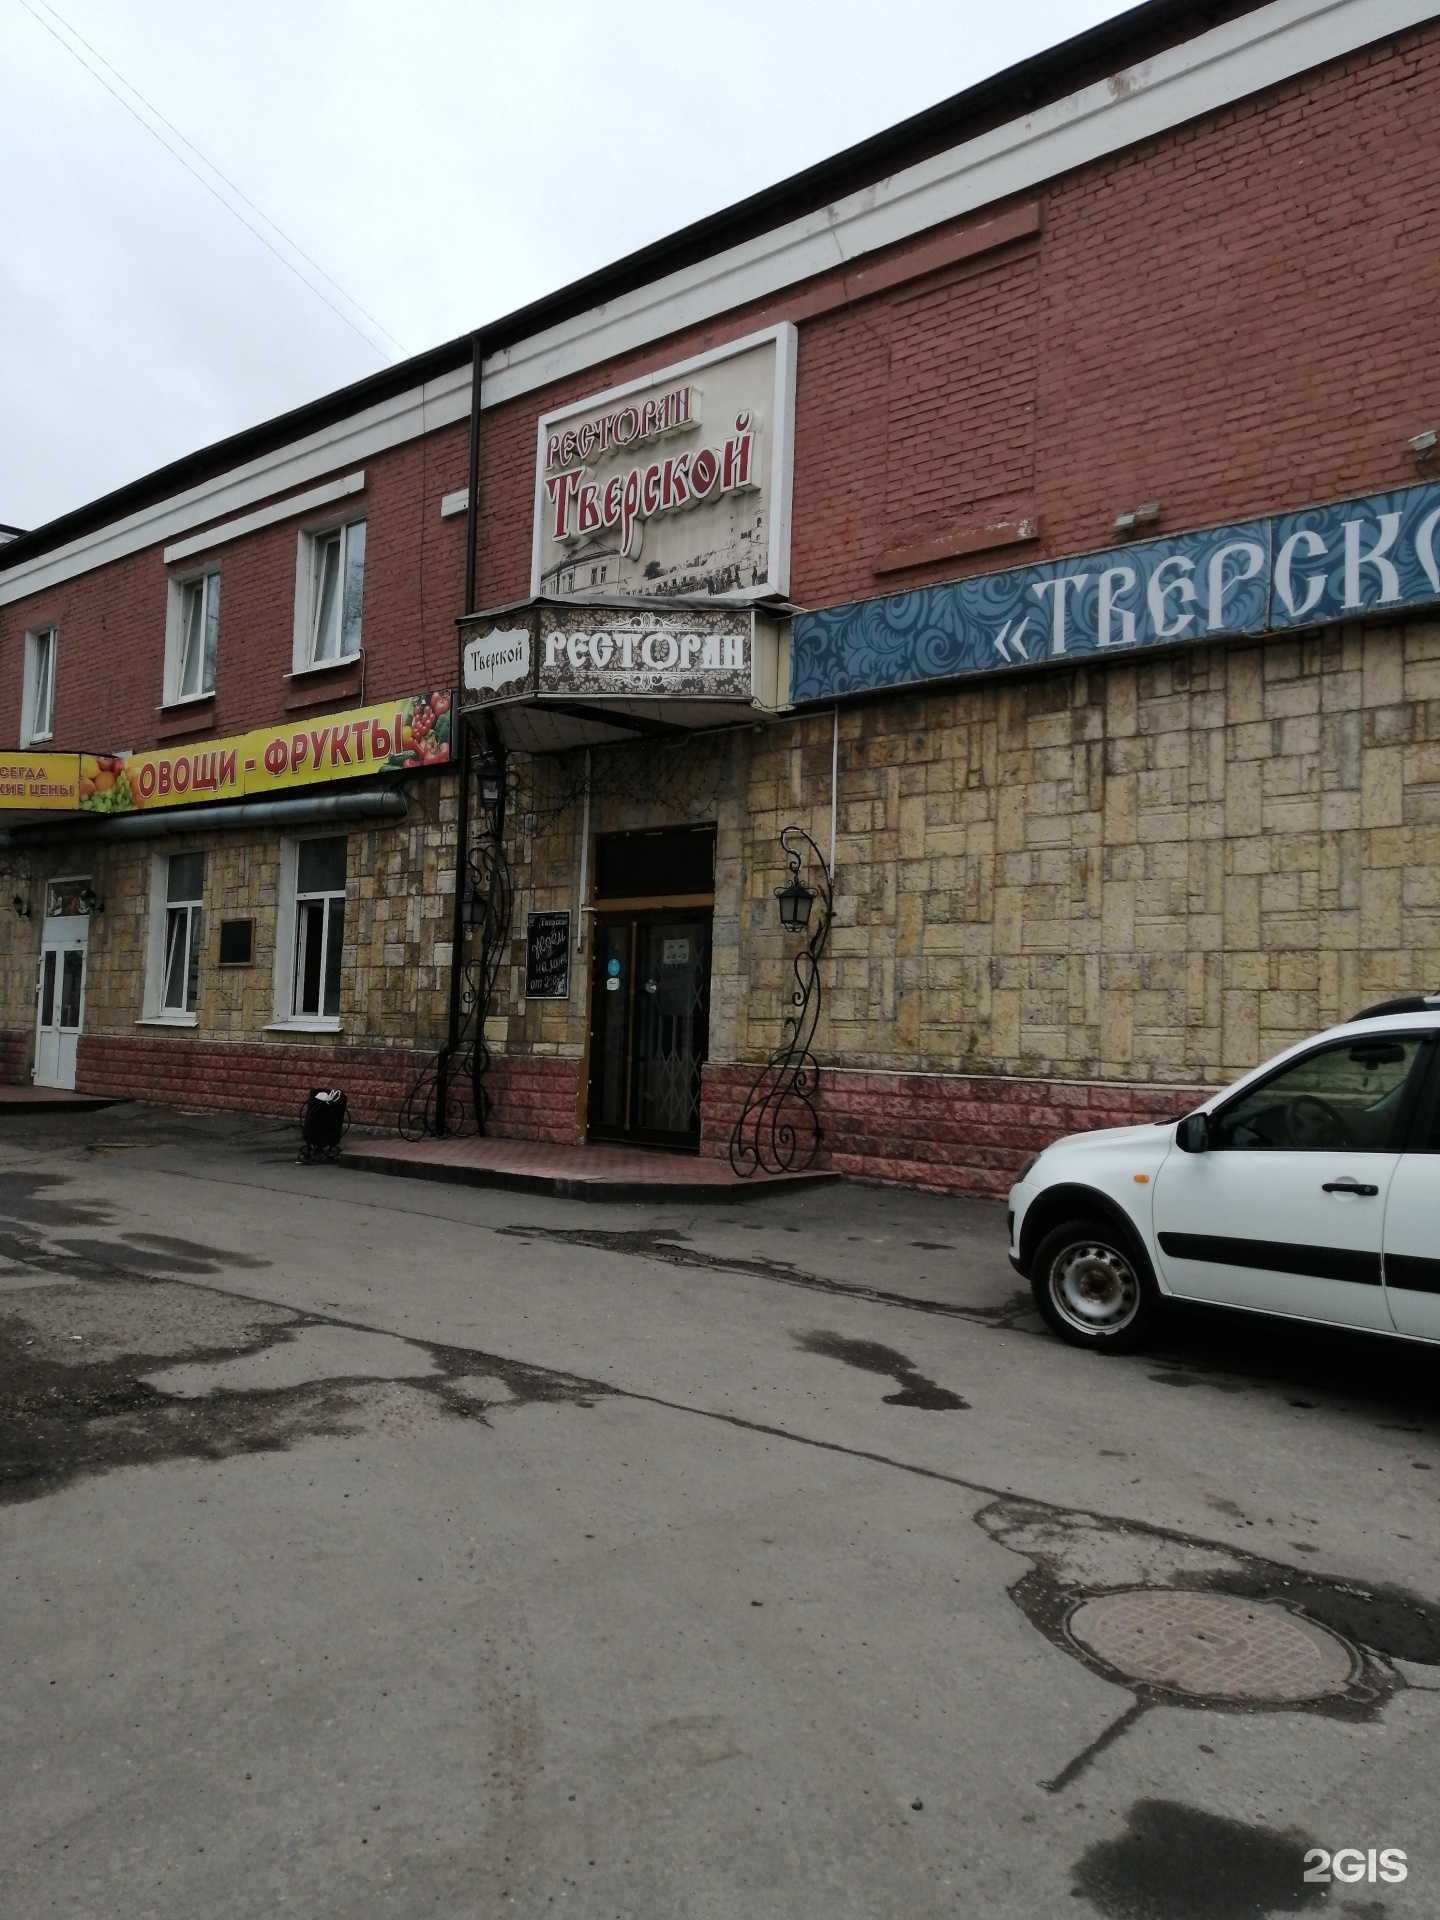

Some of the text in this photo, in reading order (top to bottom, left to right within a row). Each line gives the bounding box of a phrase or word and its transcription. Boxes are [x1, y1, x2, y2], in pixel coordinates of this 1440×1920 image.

[545, 384, 692, 470] РЕСТОРАН
[545, 410, 754, 557] Тверской
[470, 640, 523, 681] Тверской
[543, 630, 746, 671] РЕСТОРАН
[138, 748, 238, 798] ОВОЩИ
[264, 714, 406, 776] ФРУКТЫ
[30, 783, 74, 797] ЦЕНЫ
